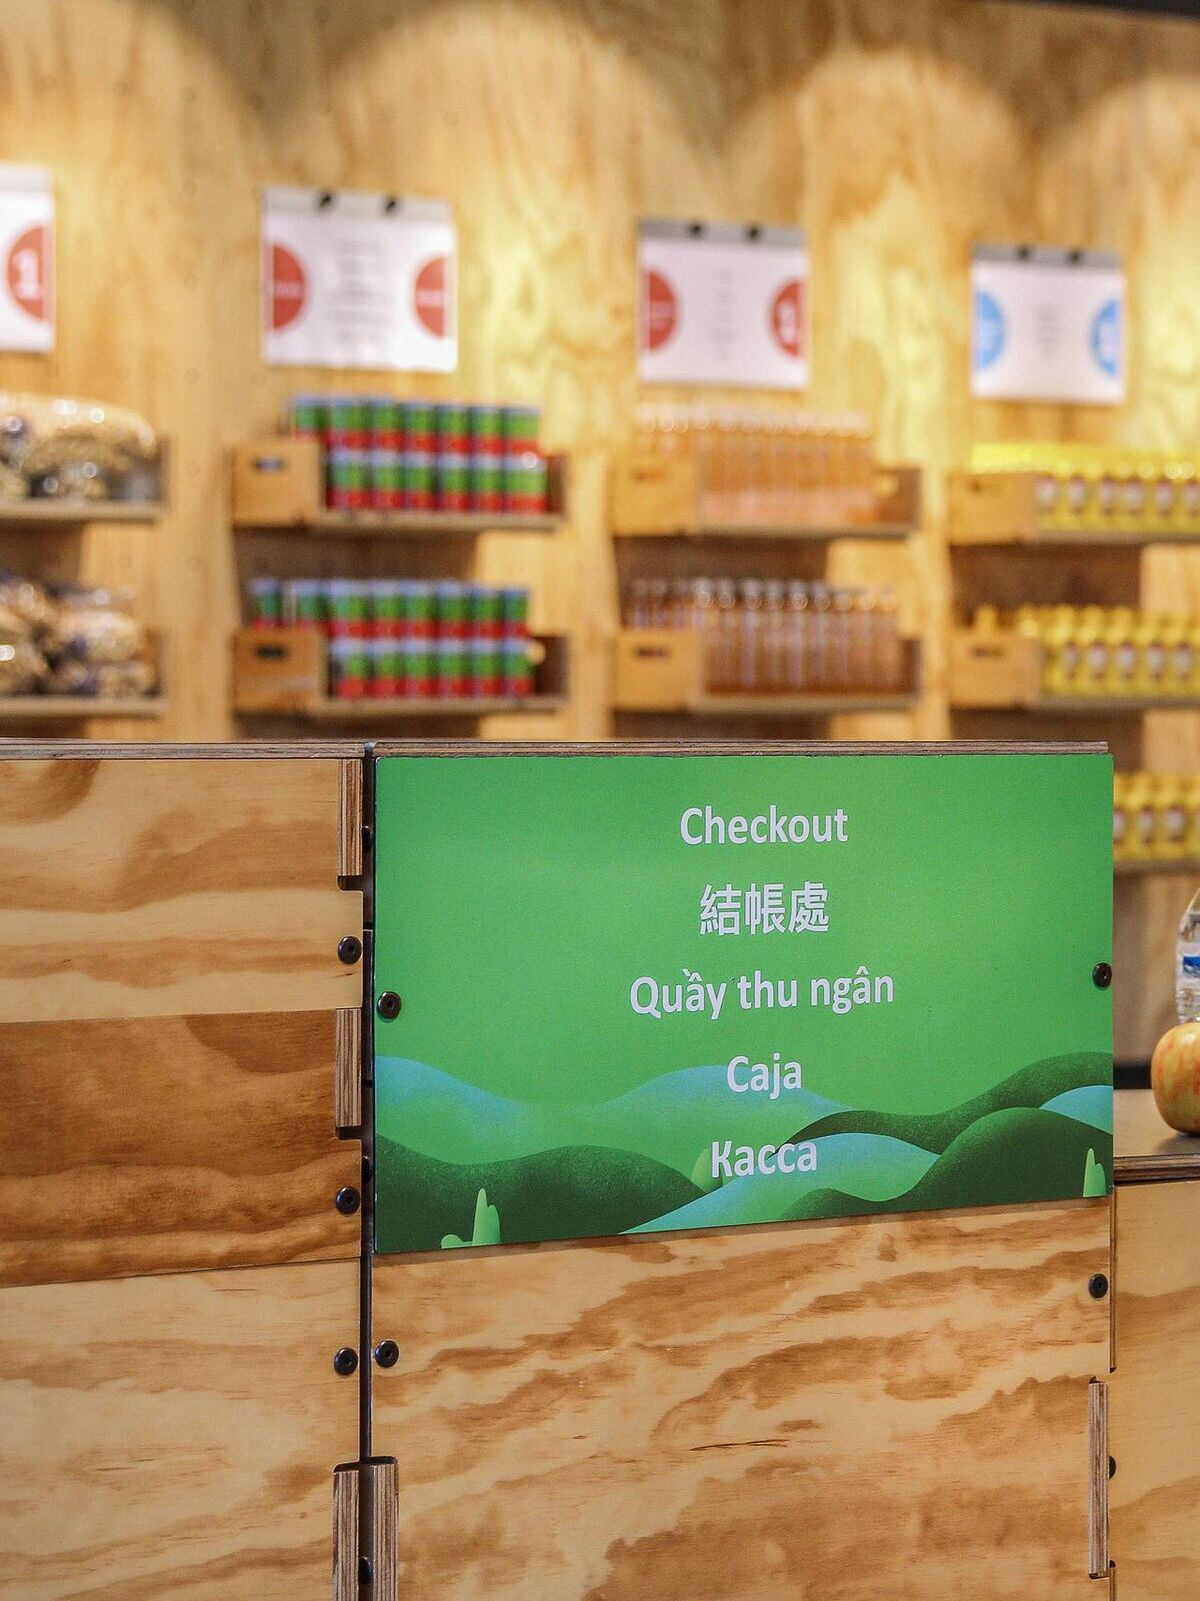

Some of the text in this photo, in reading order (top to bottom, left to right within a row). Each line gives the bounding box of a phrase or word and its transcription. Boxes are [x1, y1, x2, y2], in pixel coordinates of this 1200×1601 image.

[680, 804, 849, 845] Checkout
[699, 881, 830, 936] 結帳處
[630, 965, 894, 1020] Quầy thu ngân
[726, 1052, 803, 1100] Caja
[711, 1140, 818, 1178] Касса
